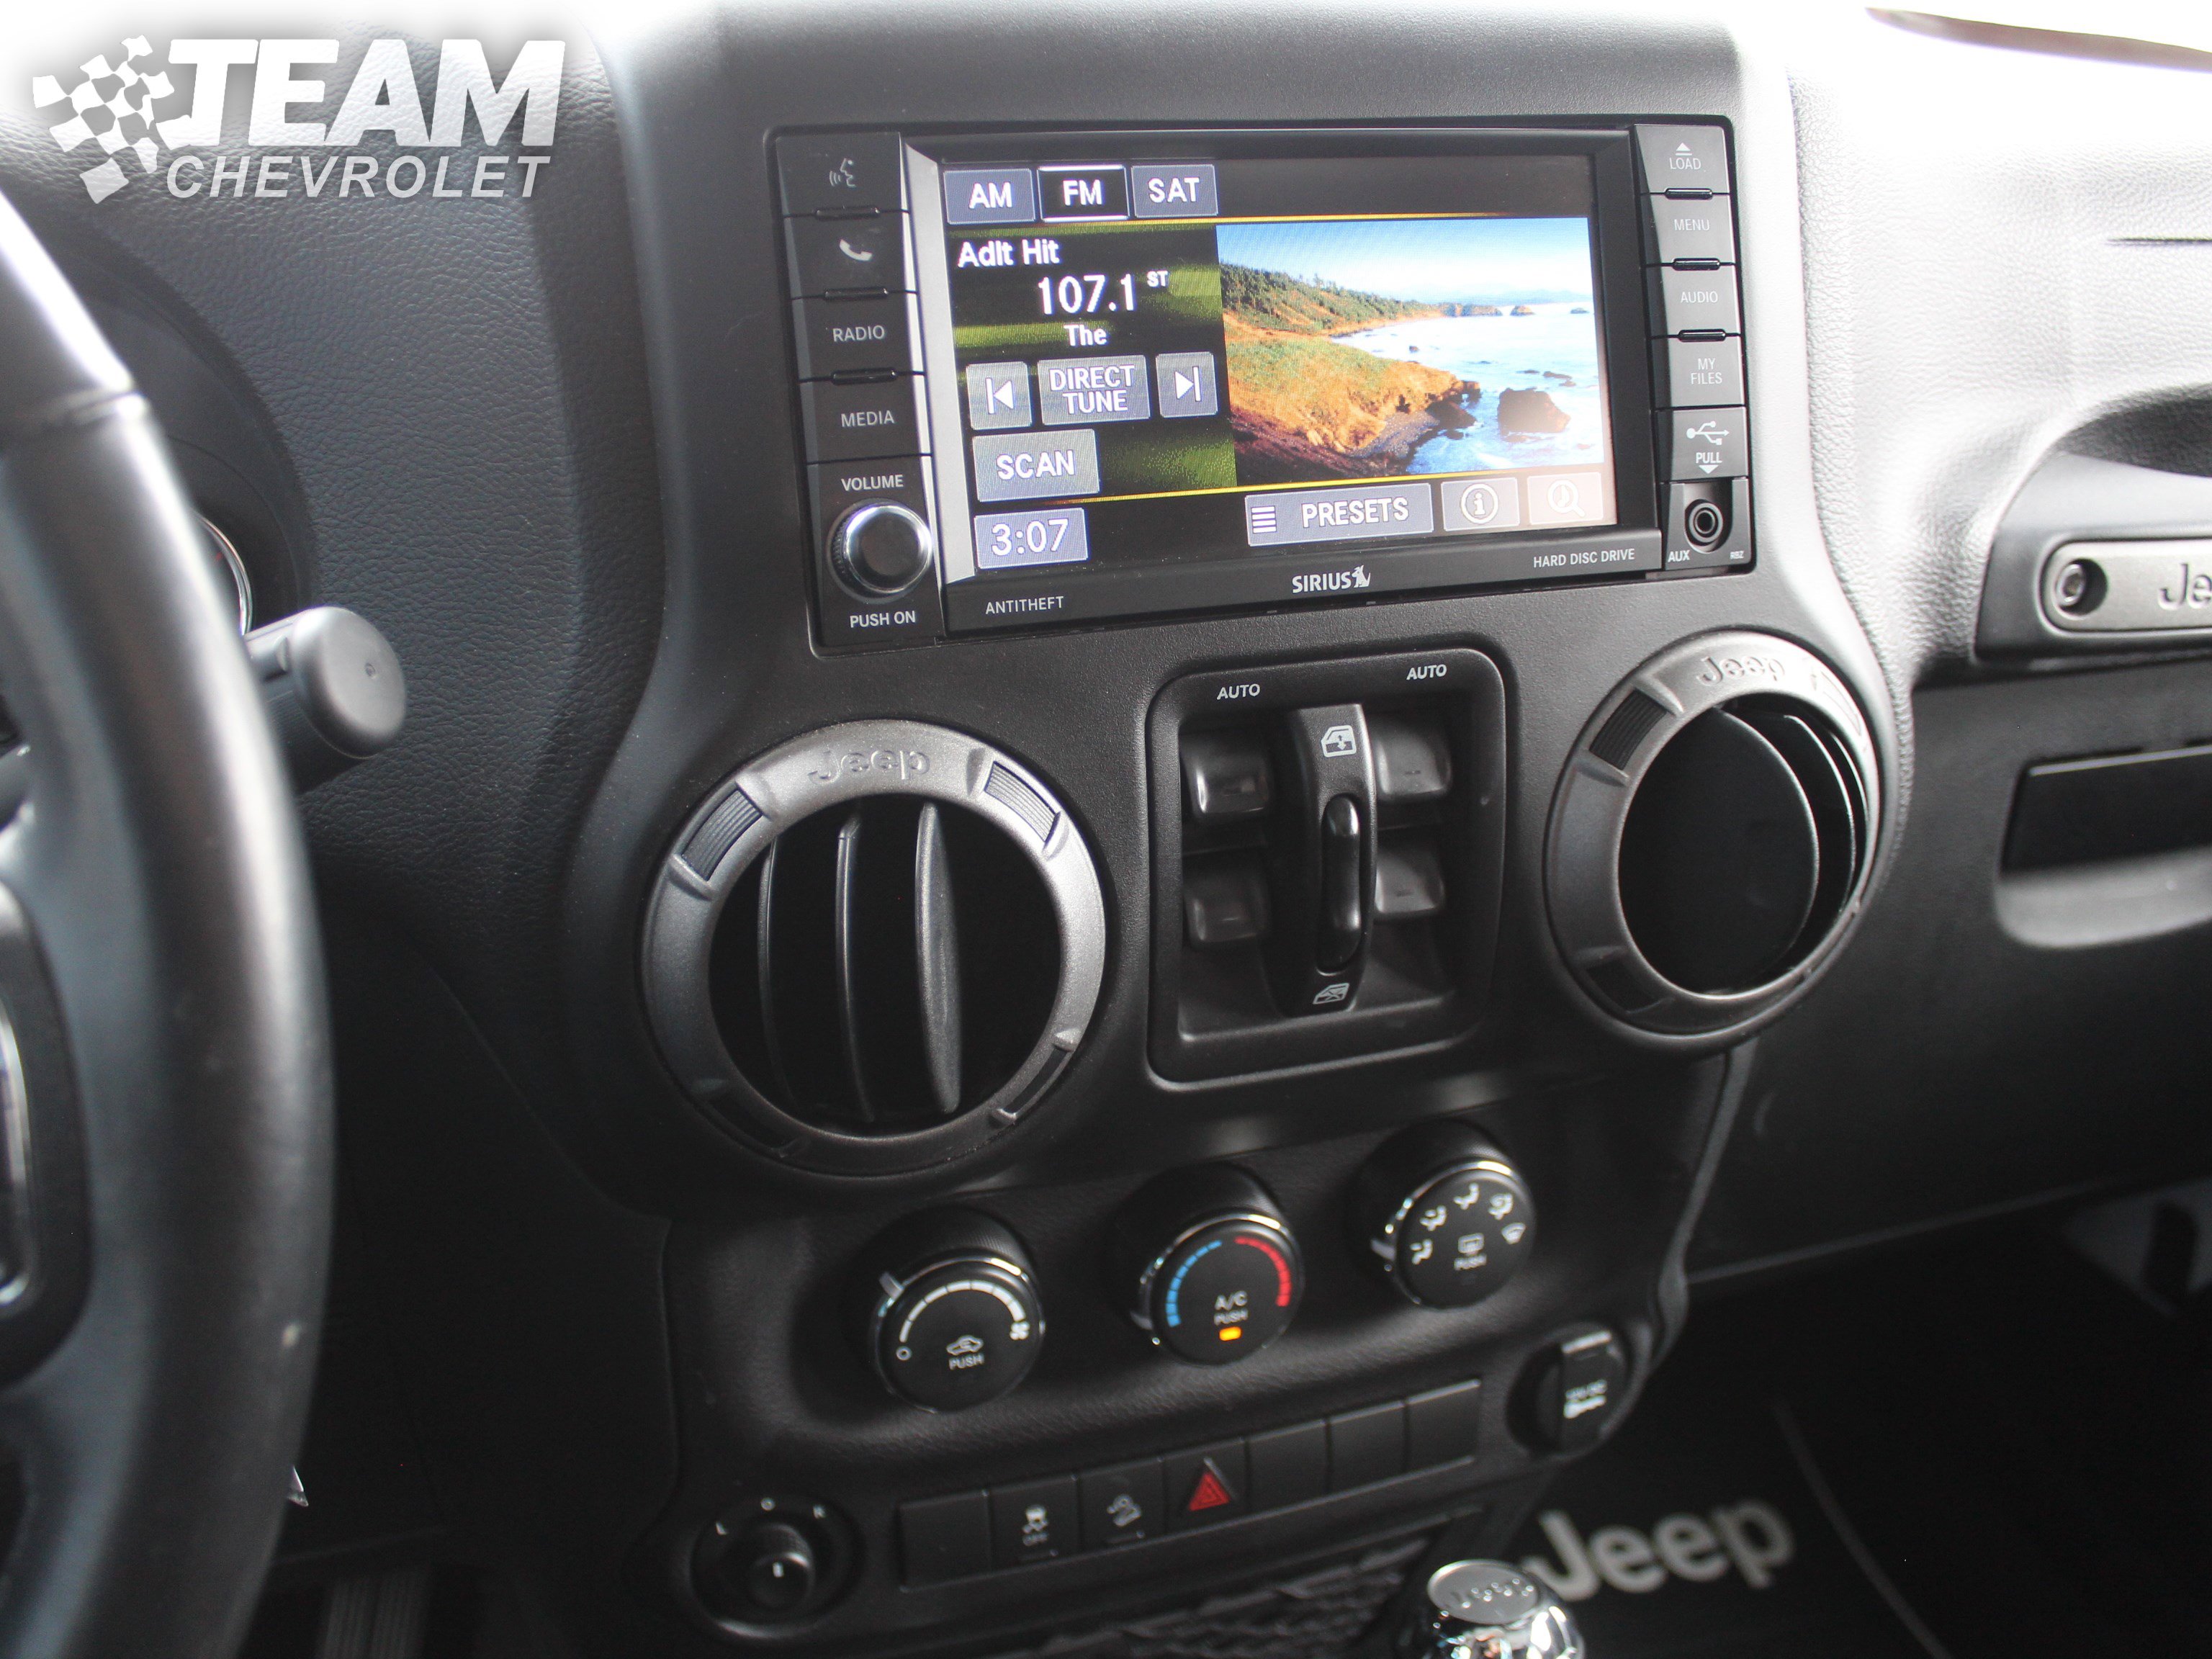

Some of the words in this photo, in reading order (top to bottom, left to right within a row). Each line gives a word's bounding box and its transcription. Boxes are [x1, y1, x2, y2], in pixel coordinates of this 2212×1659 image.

[1669, 157, 1701, 170] LOAD
[968, 181, 1014, 210] AM
[1062, 179, 1104, 206] FM
[1148, 177, 1200, 204] SAT
[1674, 218, 1710, 231] MENU
[1021, 239, 1061, 265] Hit
[1038, 273, 1136, 315] 107.1
[1147, 270, 1169, 287] ST
[1680, 291, 1718, 303] AUDIO
[832, 325, 885, 342] RADIO
[1064, 324, 1107, 346] The
[1697, 358, 1716, 370] MY
[1049, 364, 1136, 392] DIRECT
[1691, 372, 1723, 385] FILES
[1062, 389, 1128, 415] TUNE
[841, 410, 895, 428] MEDIA
[996, 449, 1075, 481] SCAN
[1695, 451, 1722, 464] PULL
[841, 474, 904, 492] VOLUME
[1301, 497, 1410, 529] PRESETS
[990, 518, 1069, 557] 3:07
[1533, 554, 1567, 568] HARD
[1570, 551, 1599, 565] DISC
[1601, 548, 1635, 563] DRIVE
[1668, 549, 1691, 563] AUX
[1292, 572, 1352, 594] SIRIUS
[985, 595, 1064, 615] ANTITHEFT
[850, 612, 890, 629] PUSH
[894, 610, 916, 625] ON
[1406, 663, 1447, 680] AUTO
[1217, 683, 1261, 700] AUTO
[807, 749, 931, 786] Jeep
[948, 1353, 985, 1370] PUSH
[1521, 1500, 1794, 1601] Jeep
